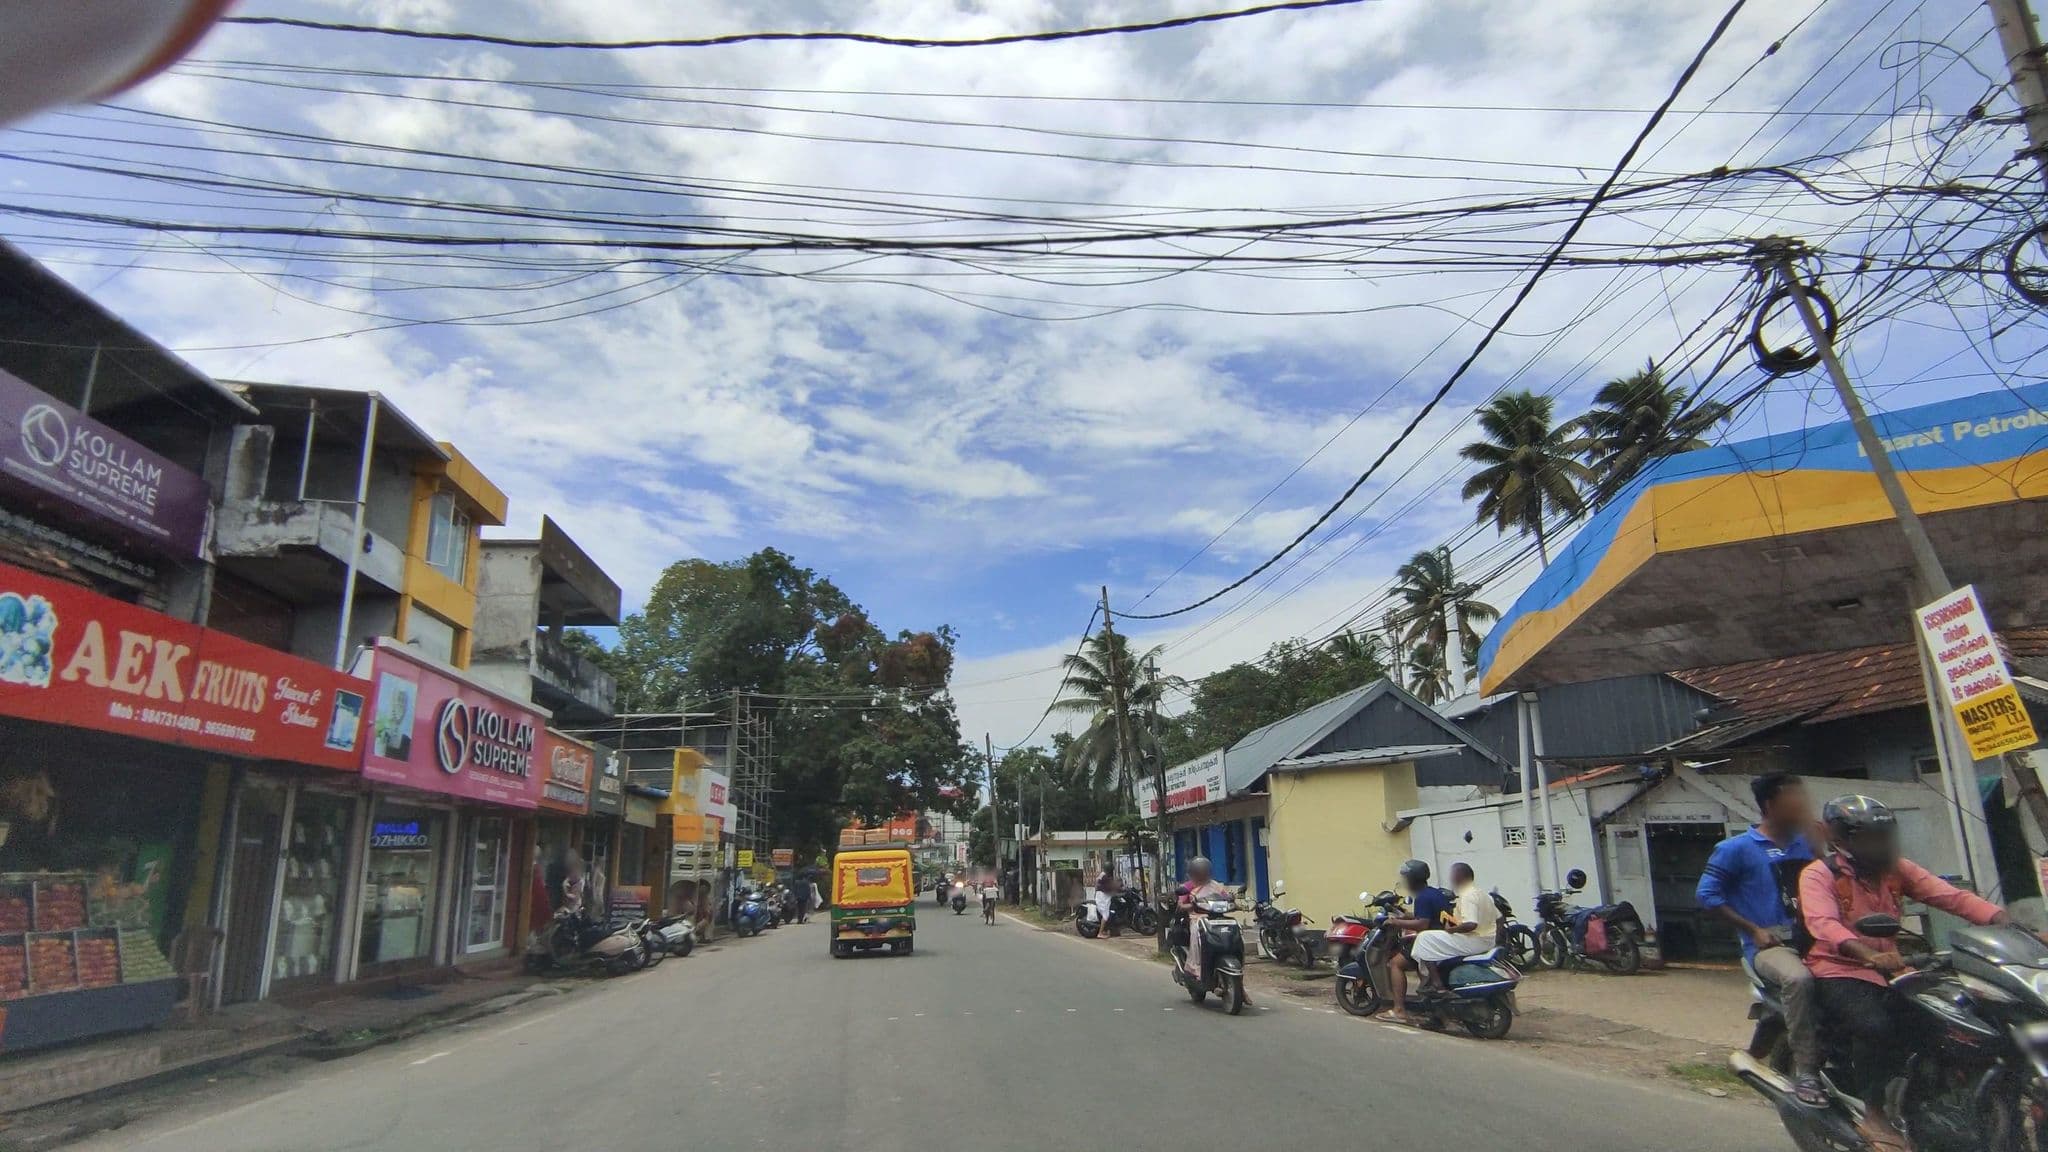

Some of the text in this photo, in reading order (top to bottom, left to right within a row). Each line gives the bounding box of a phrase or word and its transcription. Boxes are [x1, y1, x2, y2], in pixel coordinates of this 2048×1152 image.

[69, 449, 158, 507] SUPREME
[73, 425, 162, 487] KOLLAM
[60, 619, 268, 714] AEK FRUITS
[475, 706, 536, 752] KOLLAM
[472, 740, 533, 778] SUPREME
